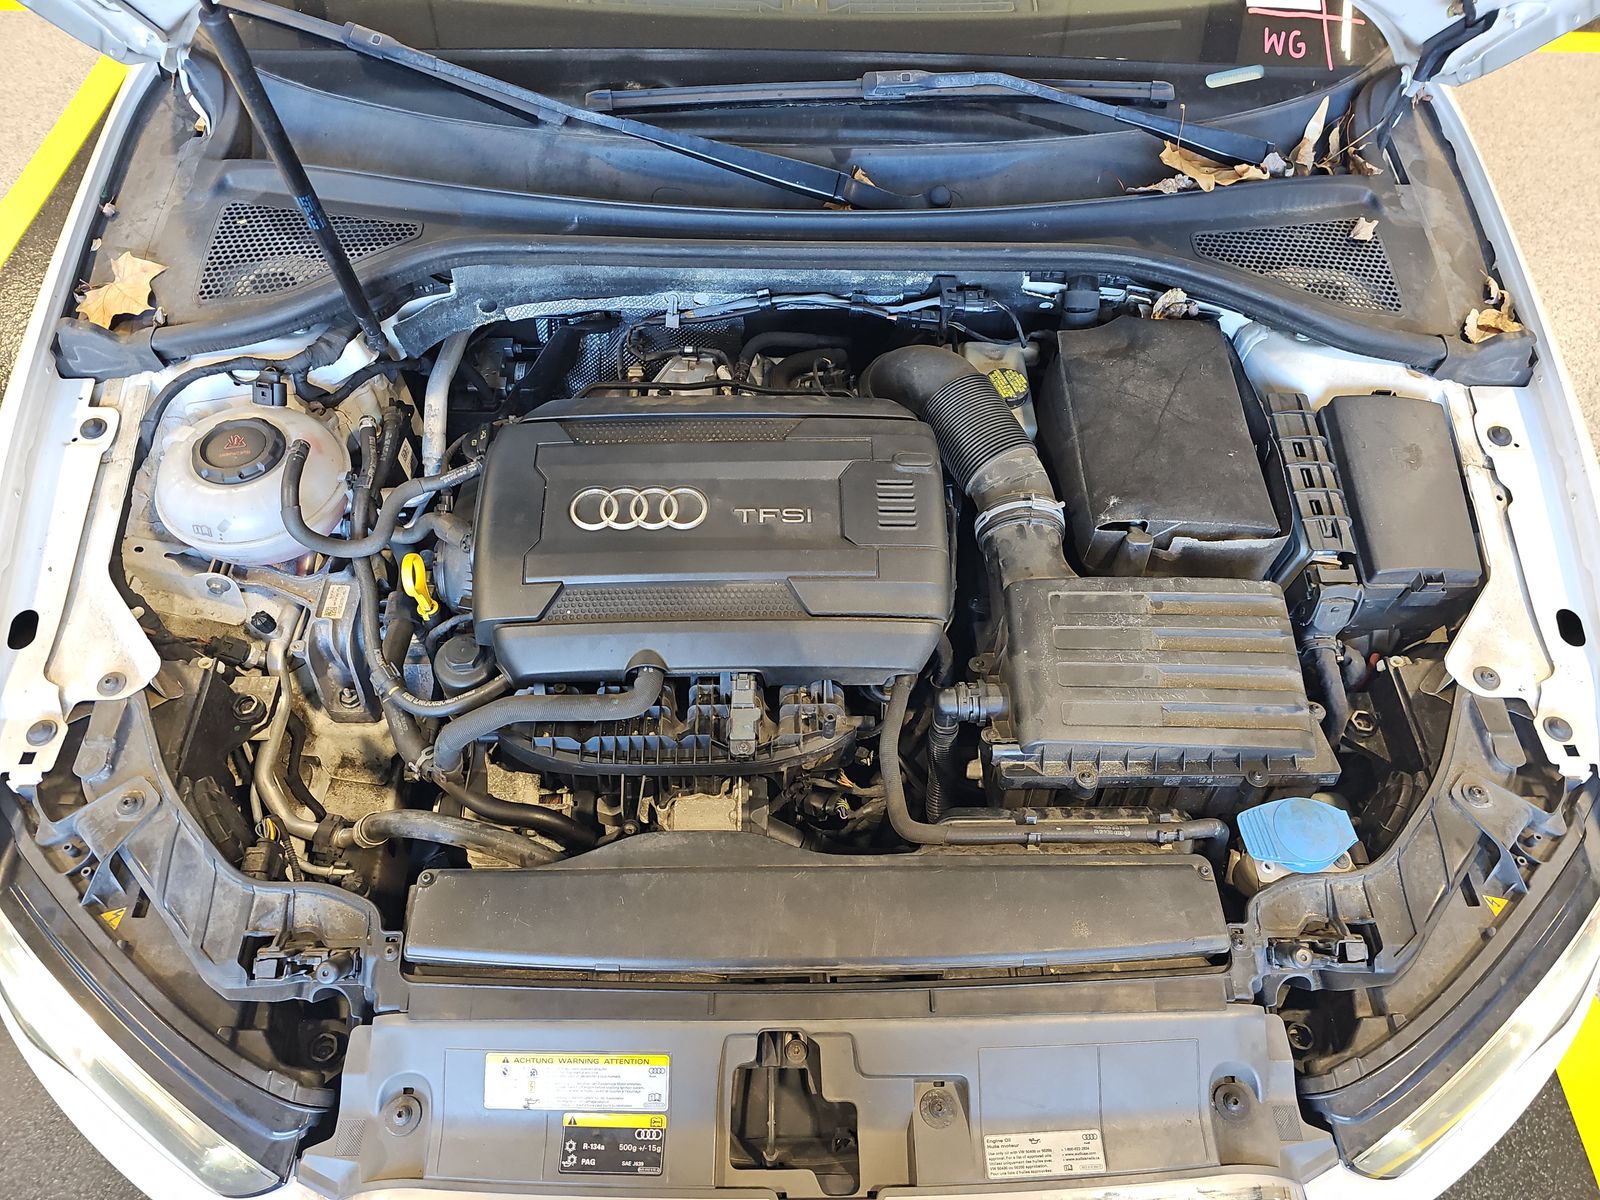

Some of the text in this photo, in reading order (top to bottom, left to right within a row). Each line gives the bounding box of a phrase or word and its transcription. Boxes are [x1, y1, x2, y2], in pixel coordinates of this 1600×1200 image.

[1264, 26, 1306, 59] WG
[733, 508, 812, 523] TFSI
[558, 1057, 600, 1065] WARNING
[582, 1142, 605, 1150] R-134a
[619, 1144, 637, 1152] 500g
